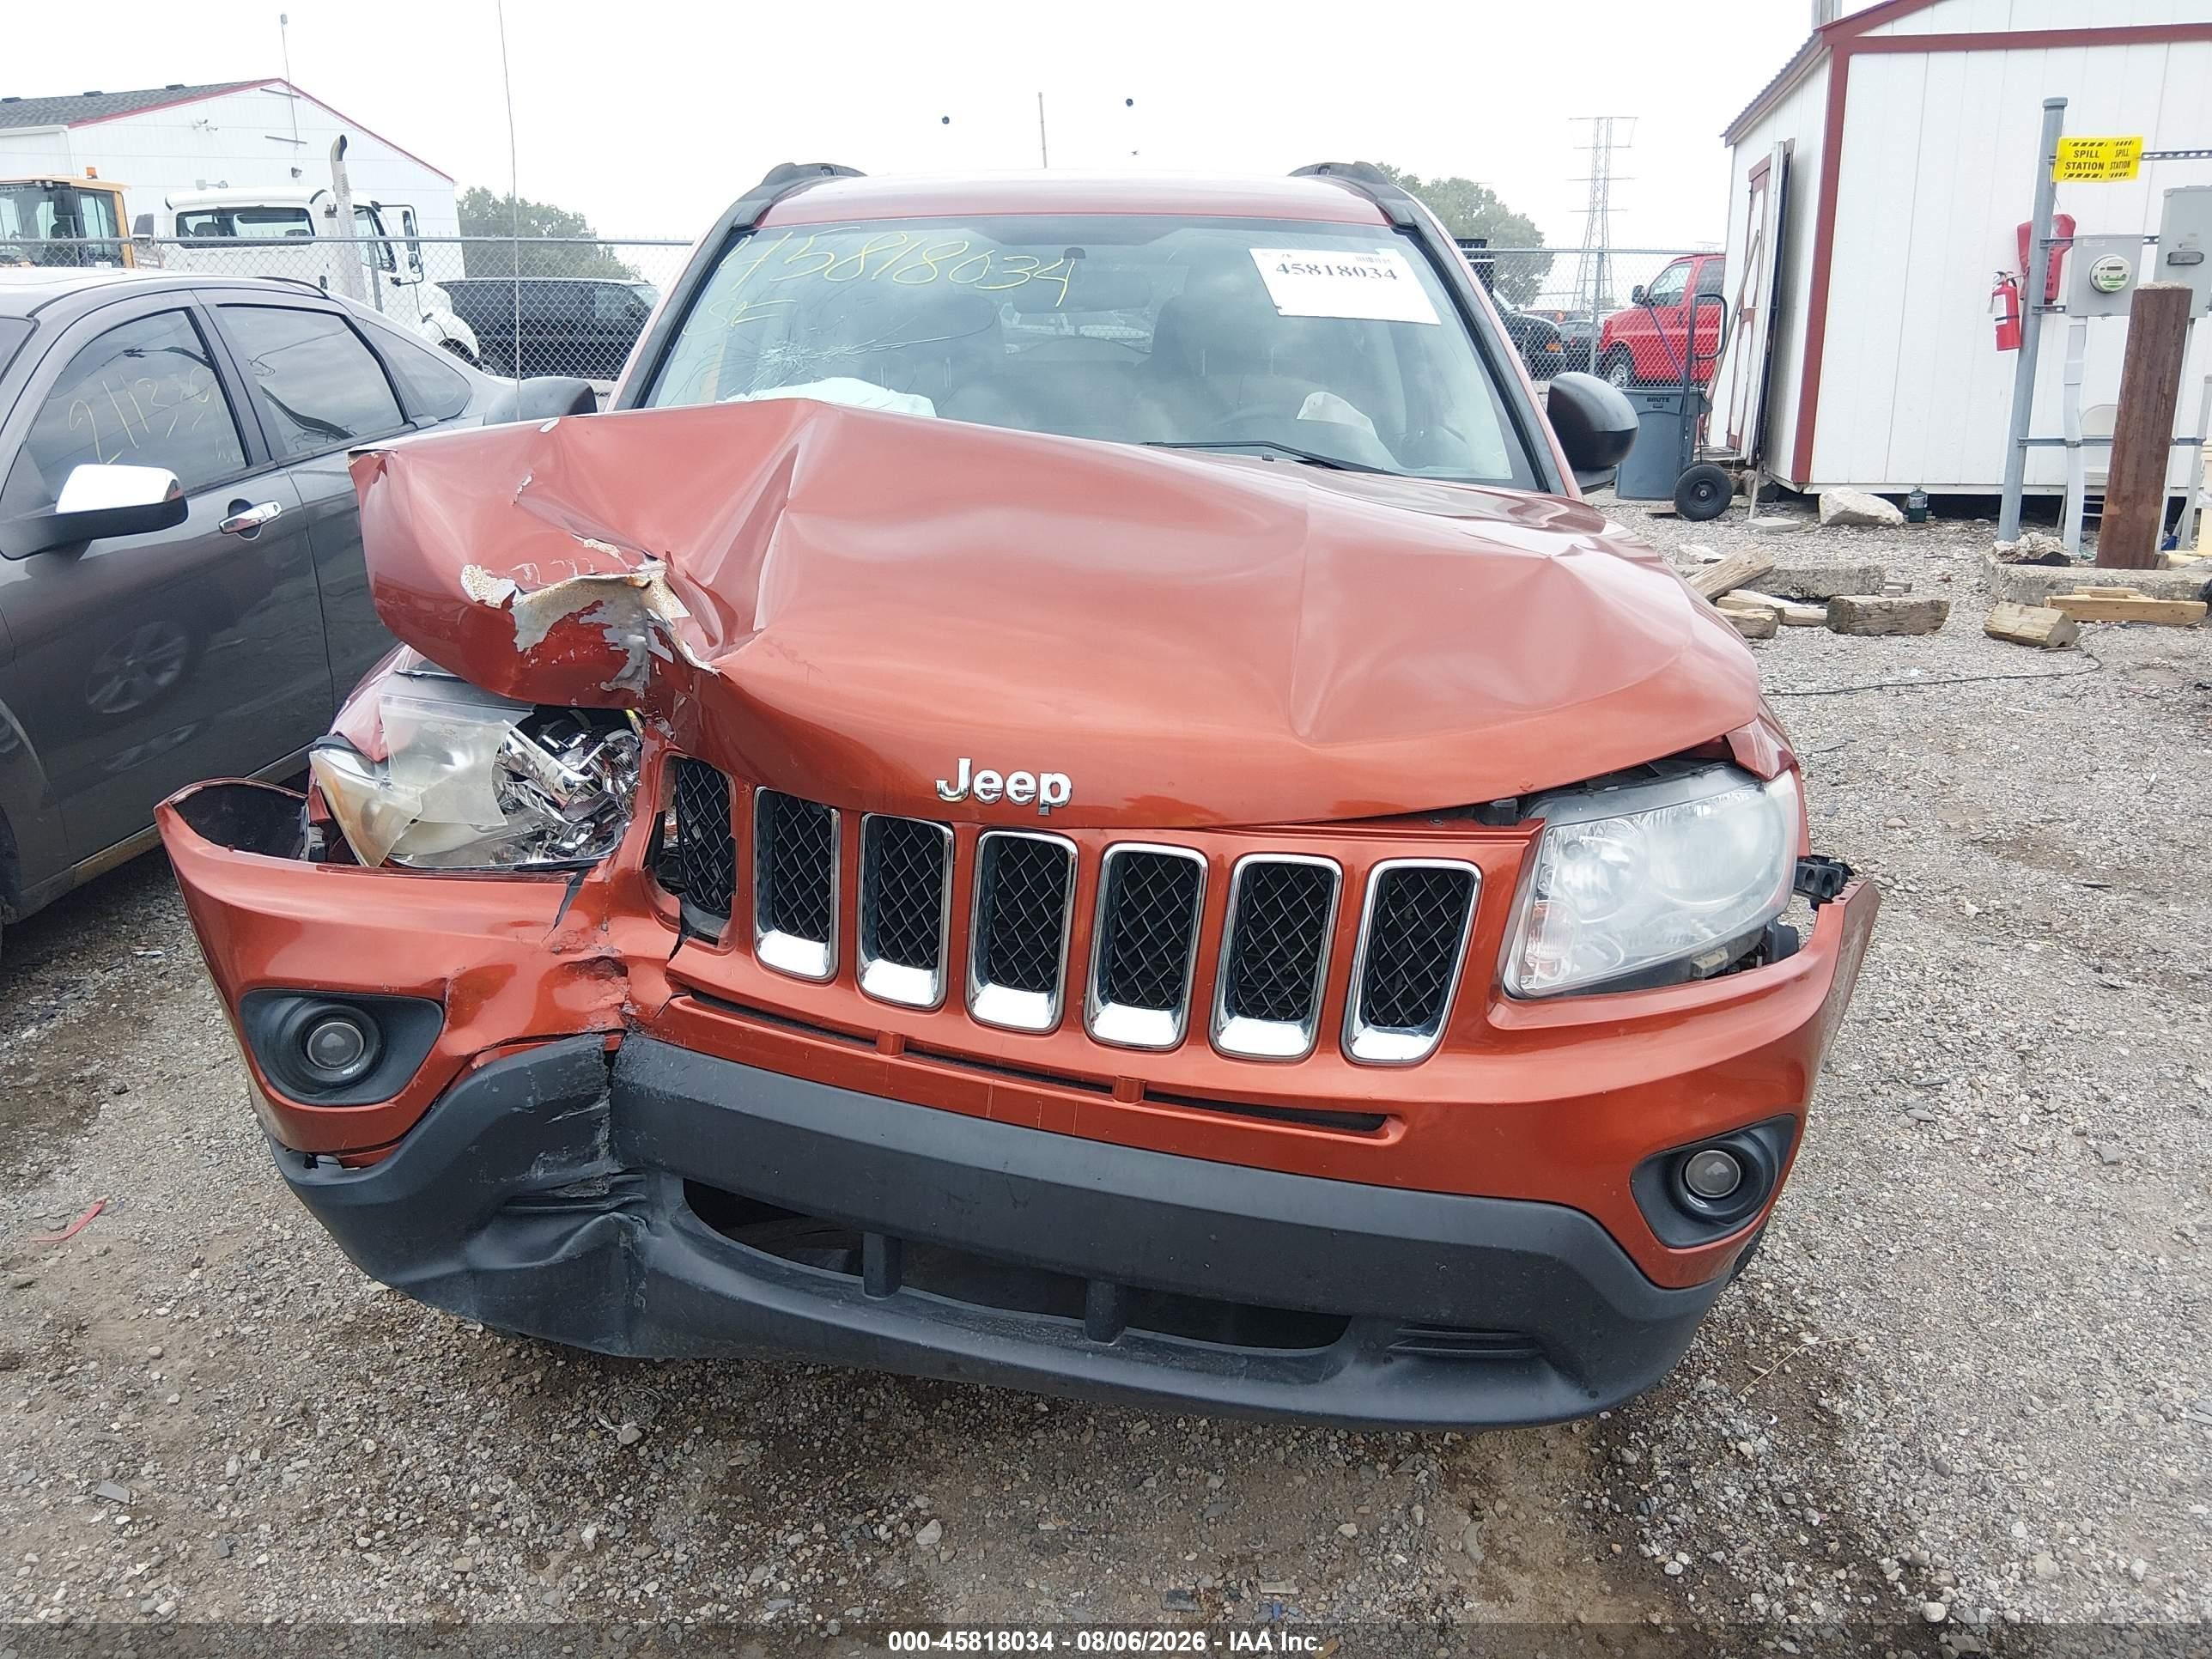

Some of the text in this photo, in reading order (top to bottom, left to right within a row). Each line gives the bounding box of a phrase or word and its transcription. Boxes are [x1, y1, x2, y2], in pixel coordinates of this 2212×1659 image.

[2073, 149, 2100, 159] SPILL
[2114, 148, 2130, 158] SPILL
[2064, 161, 2105, 170] STATION
[2109, 160, 2131, 170] STATION
[1275, 263, 1398, 281] 45818034
[935, 757, 1073, 816] Jeep
